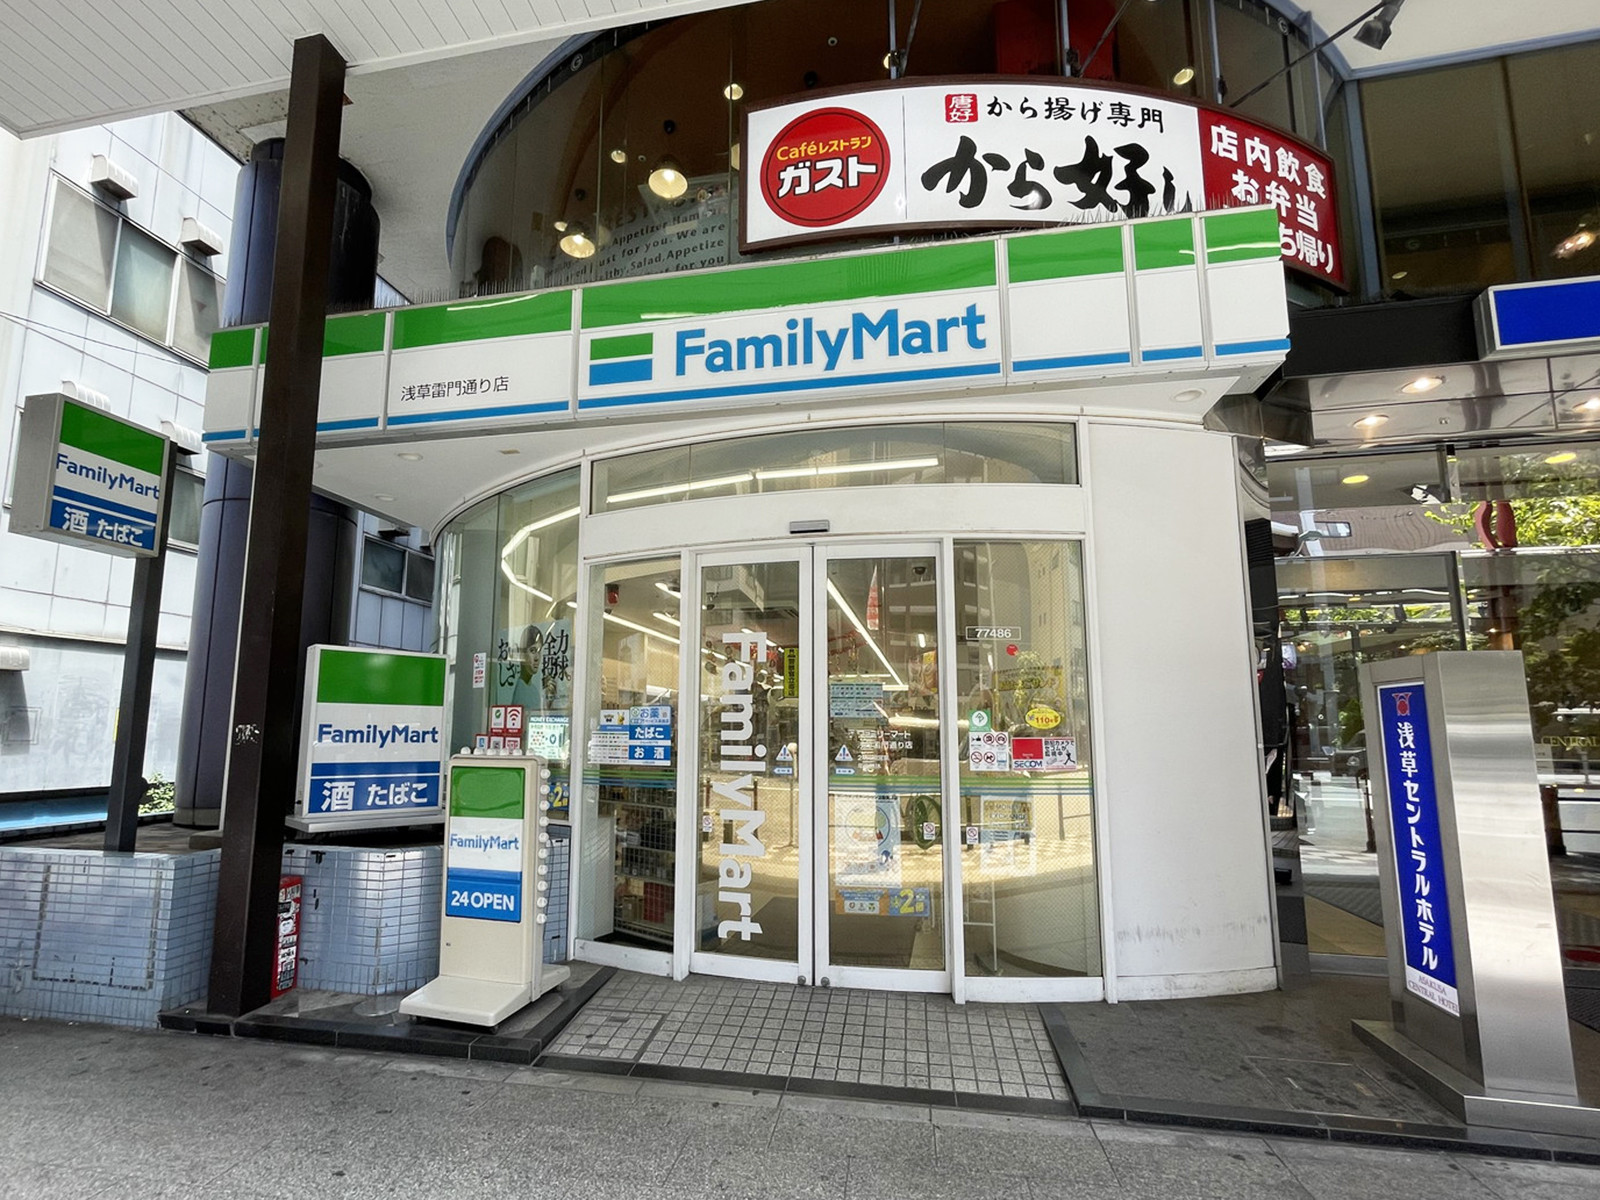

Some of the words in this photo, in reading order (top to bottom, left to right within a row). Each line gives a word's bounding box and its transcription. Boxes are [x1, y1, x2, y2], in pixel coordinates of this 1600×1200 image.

[949, 95, 974, 123] 唐好
[987, 95, 1164, 133] から揚げ専門
[778, 155, 877, 198] ガスト
[1210, 125, 1327, 199] 店内飲食
[1231, 169, 1319, 232] お弁当
[676, 229, 697, 240] We
[702, 223, 725, 234] are
[676, 303, 987, 376] FamilyMart
[401, 376, 509, 401] 浅草雷門通り店
[56, 453, 160, 500] FamilyMart
[62, 506, 90, 535] 酒
[96, 518, 144, 547] たばこ
[975, 628, 1012, 638] 77486
[318, 724, 438, 749] FamilyMart
[635, 727, 665, 739] たばこ
[1014, 760, 1042, 768] SECOM
[321, 781, 355, 811] 酒
[366, 782, 428, 806] たばこ
[712, 632, 767, 941] FamilyMart
[450, 833, 519, 852] FamilyMart
[1397, 722, 1438, 971] 浅草セントラルホテル
[451, 890, 469, 907] 24
[470, 891, 515, 911] OPEN
